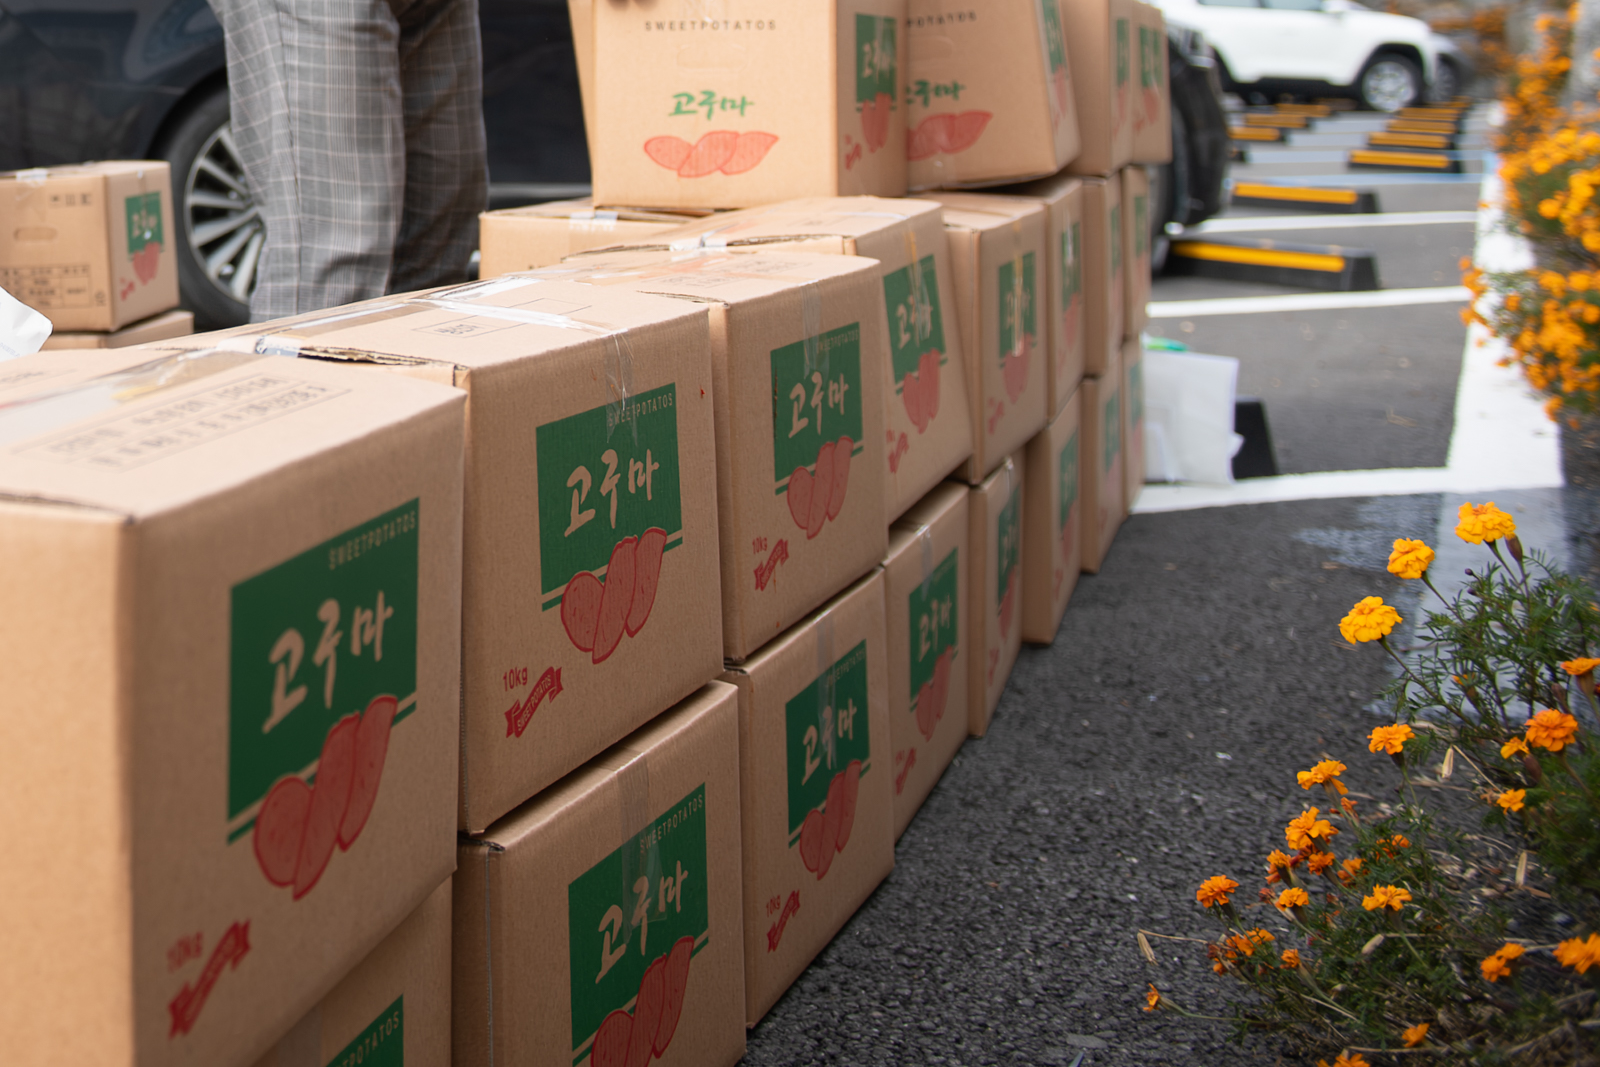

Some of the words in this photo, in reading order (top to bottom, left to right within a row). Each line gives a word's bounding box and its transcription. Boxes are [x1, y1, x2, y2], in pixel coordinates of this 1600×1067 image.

[644, 19, 777, 32] SWEETPOTATOS
[667, 89, 756, 122] 고구마
[788, 371, 850, 439] 고구마
[564, 448, 660, 538] 고구마
[328, 509, 416, 571] SWEETPOTATOS
[261, 589, 395, 735] 고구마
[502, 666, 528, 693] 10kg
[801, 696, 859, 787] 고구마
[639, 793, 704, 855] SWEETPOTATOS
[595, 860, 690, 985] 고구마
